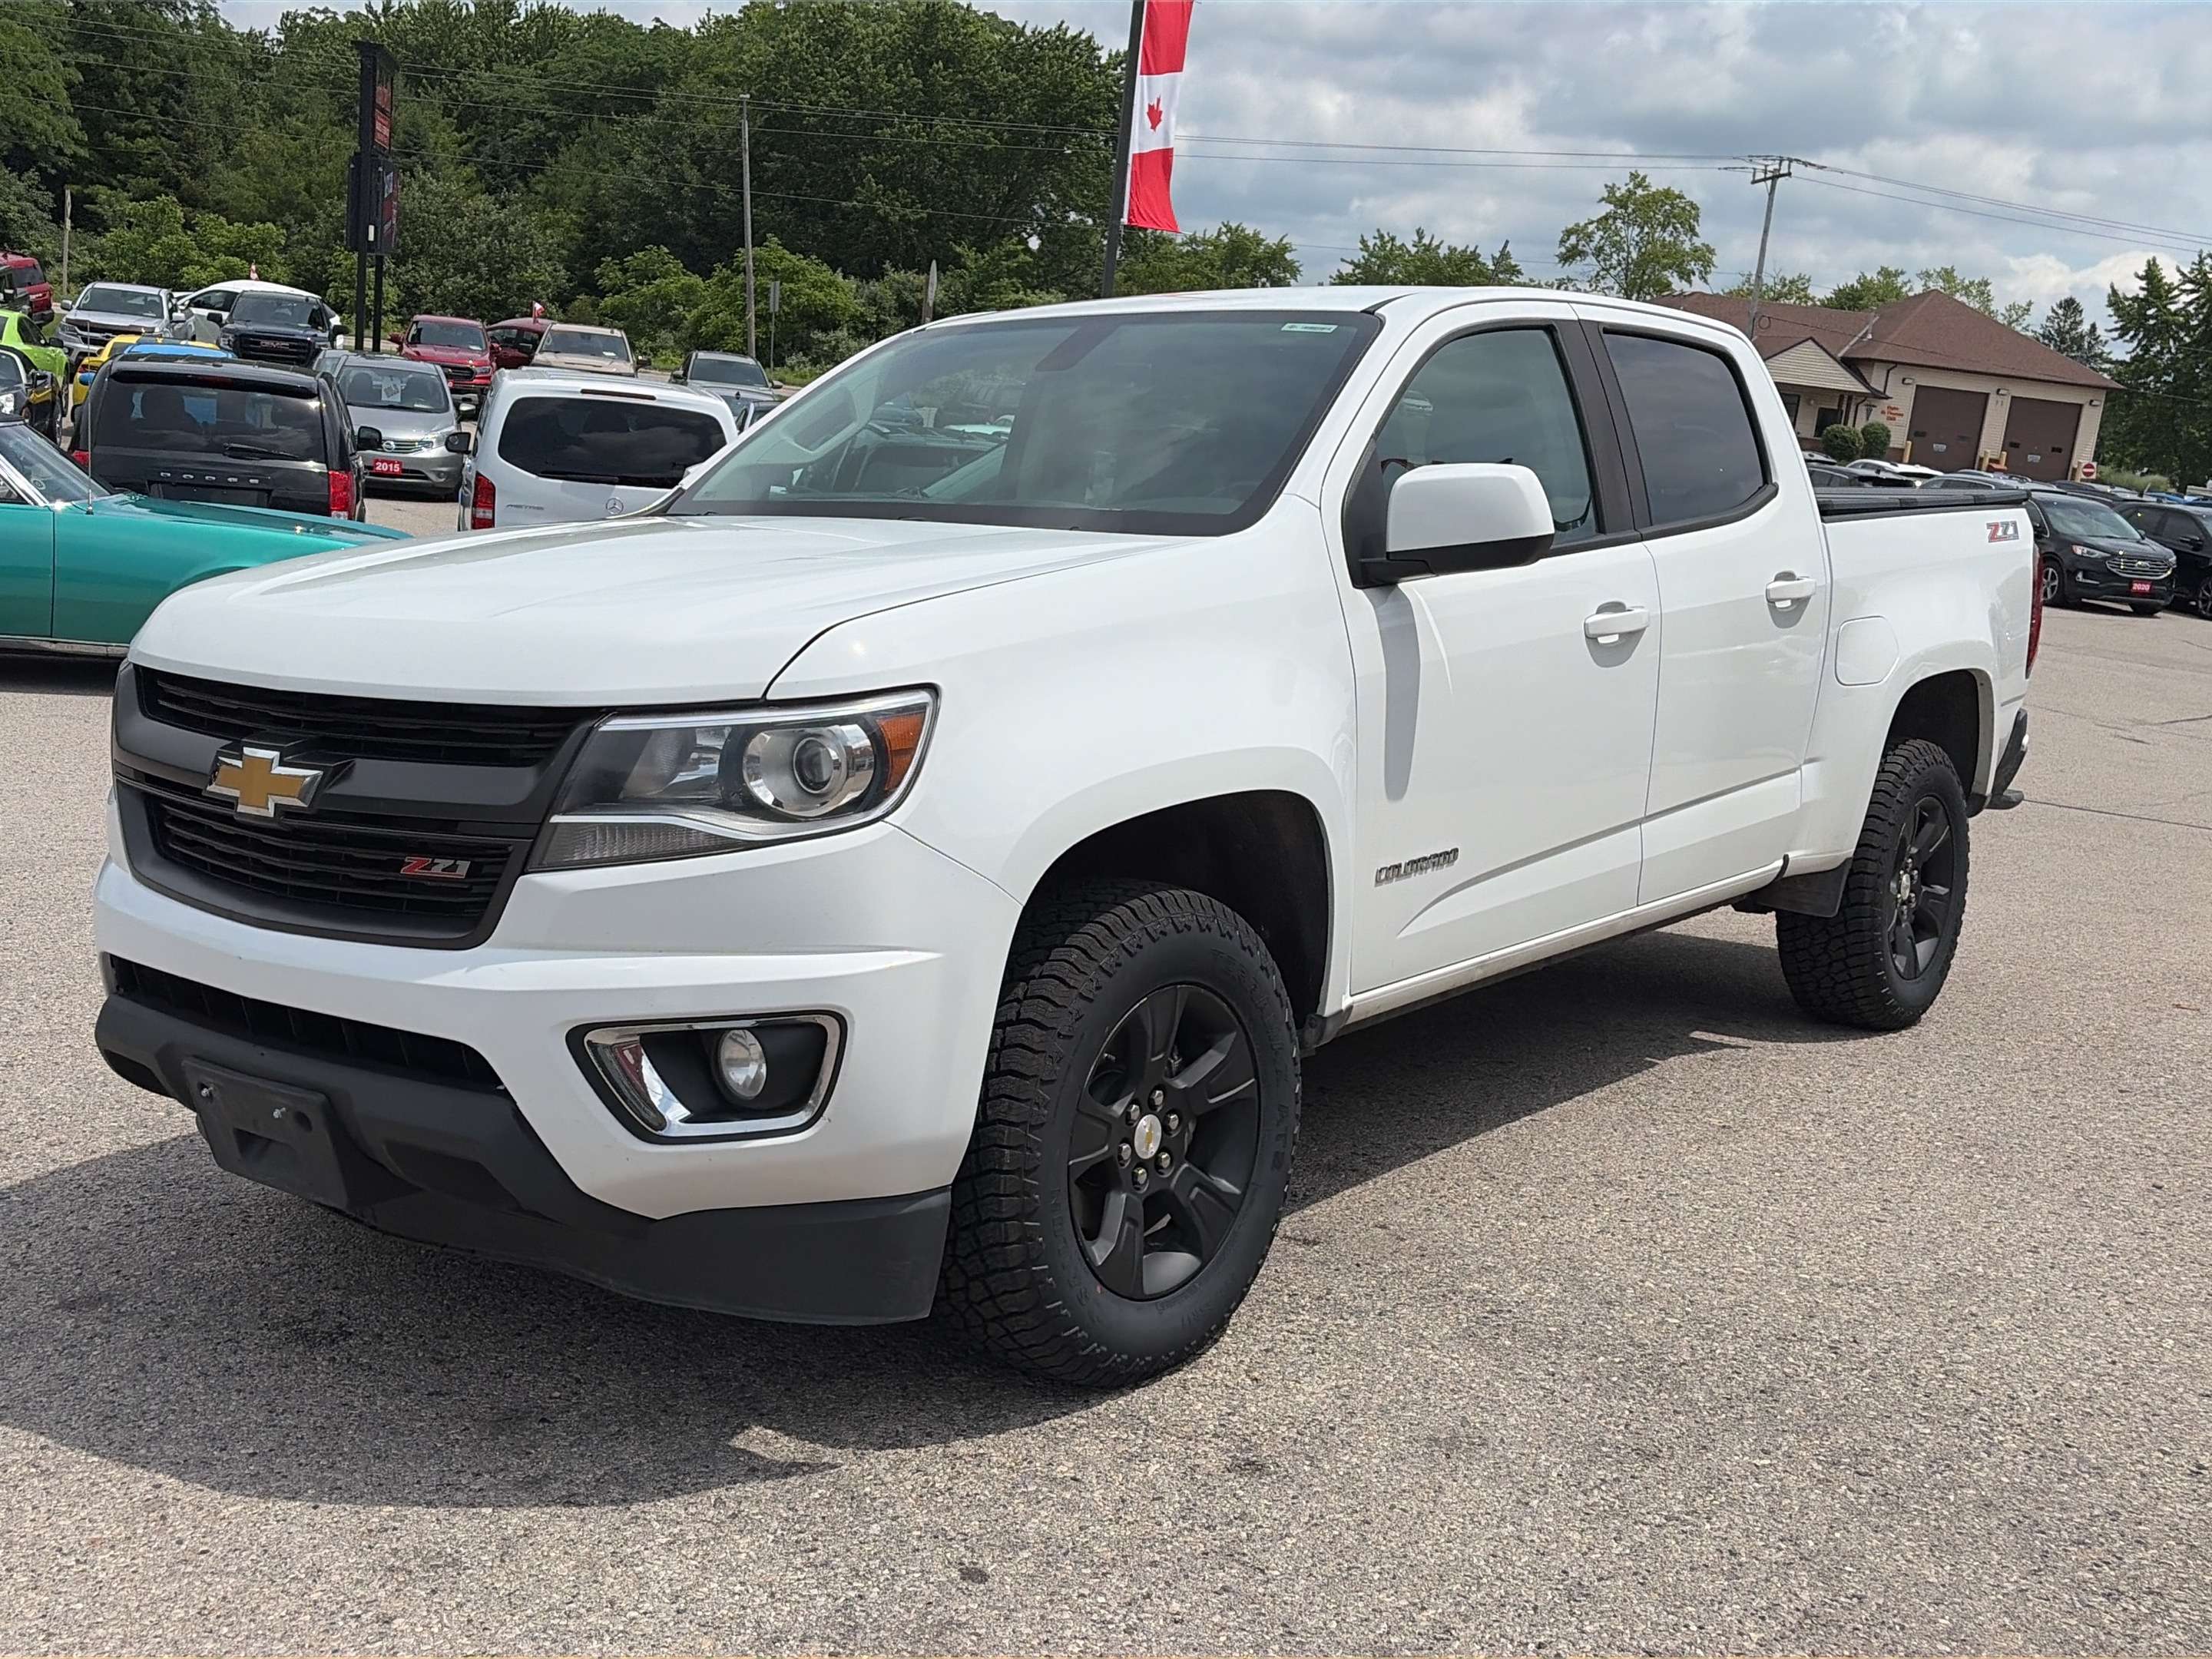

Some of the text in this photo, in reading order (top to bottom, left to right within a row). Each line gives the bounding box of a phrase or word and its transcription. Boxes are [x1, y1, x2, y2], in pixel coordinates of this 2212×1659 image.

[375, 461, 400, 472] 2015
[1985, 520, 2020, 543] Z71
[400, 856, 471, 879] Z71
[1374, 846, 1459, 886] COLORADO
